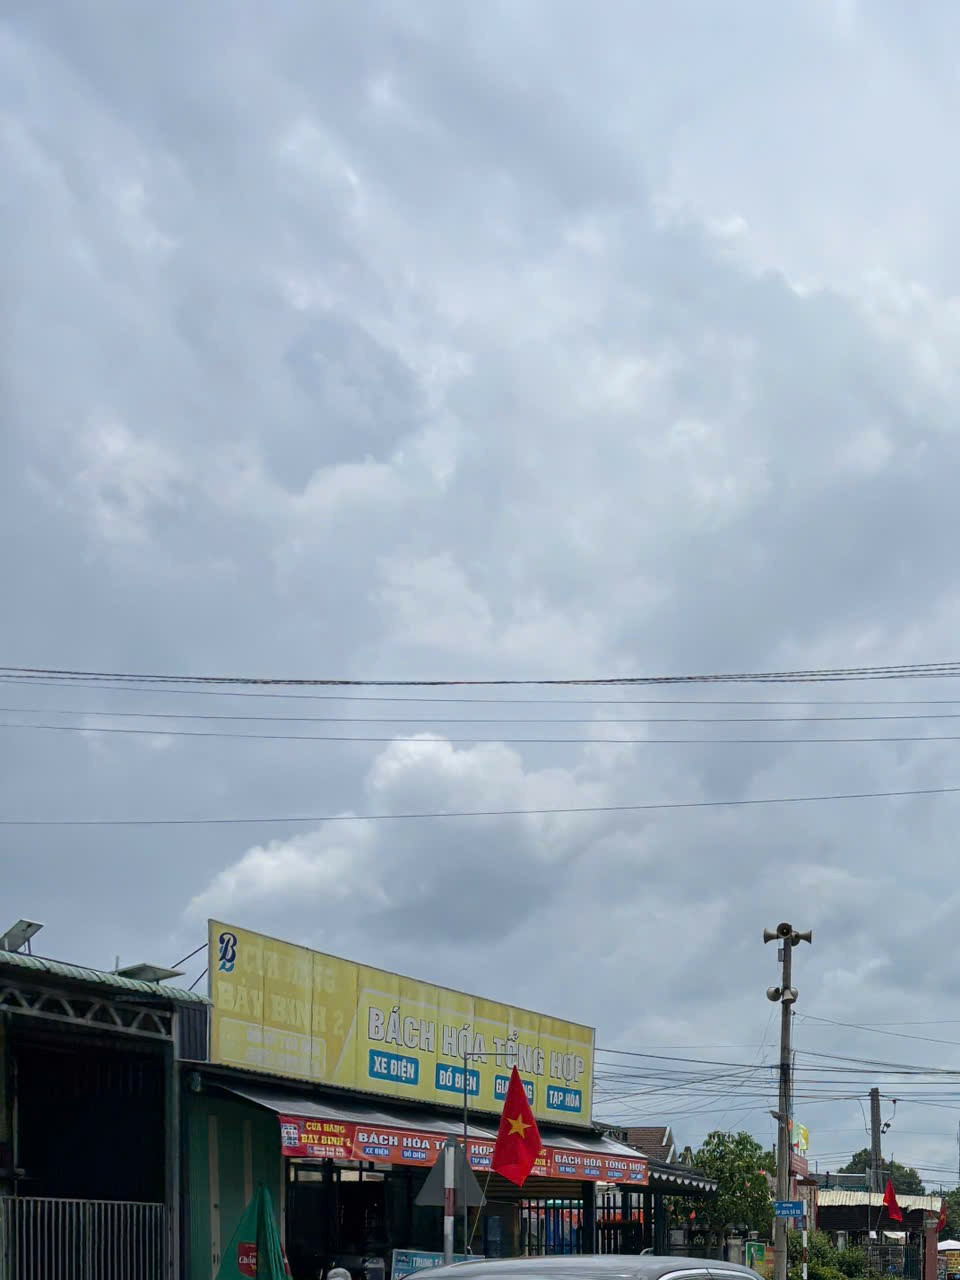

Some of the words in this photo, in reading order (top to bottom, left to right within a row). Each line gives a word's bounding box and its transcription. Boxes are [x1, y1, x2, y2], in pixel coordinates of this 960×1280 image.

[368, 1006, 435, 1053] BÁCH
[442, 1024, 487, 1064] HÓA
[493, 1030, 545, 1076] TỔNG
[550, 1051, 585, 1087] HỢP
[374, 1056, 387, 1073] XE
[390, 1059, 415, 1080] ĐIỆN
[549, 1091, 563, 1107] TẠP
[358, 1132, 398, 1146] BÁCH
